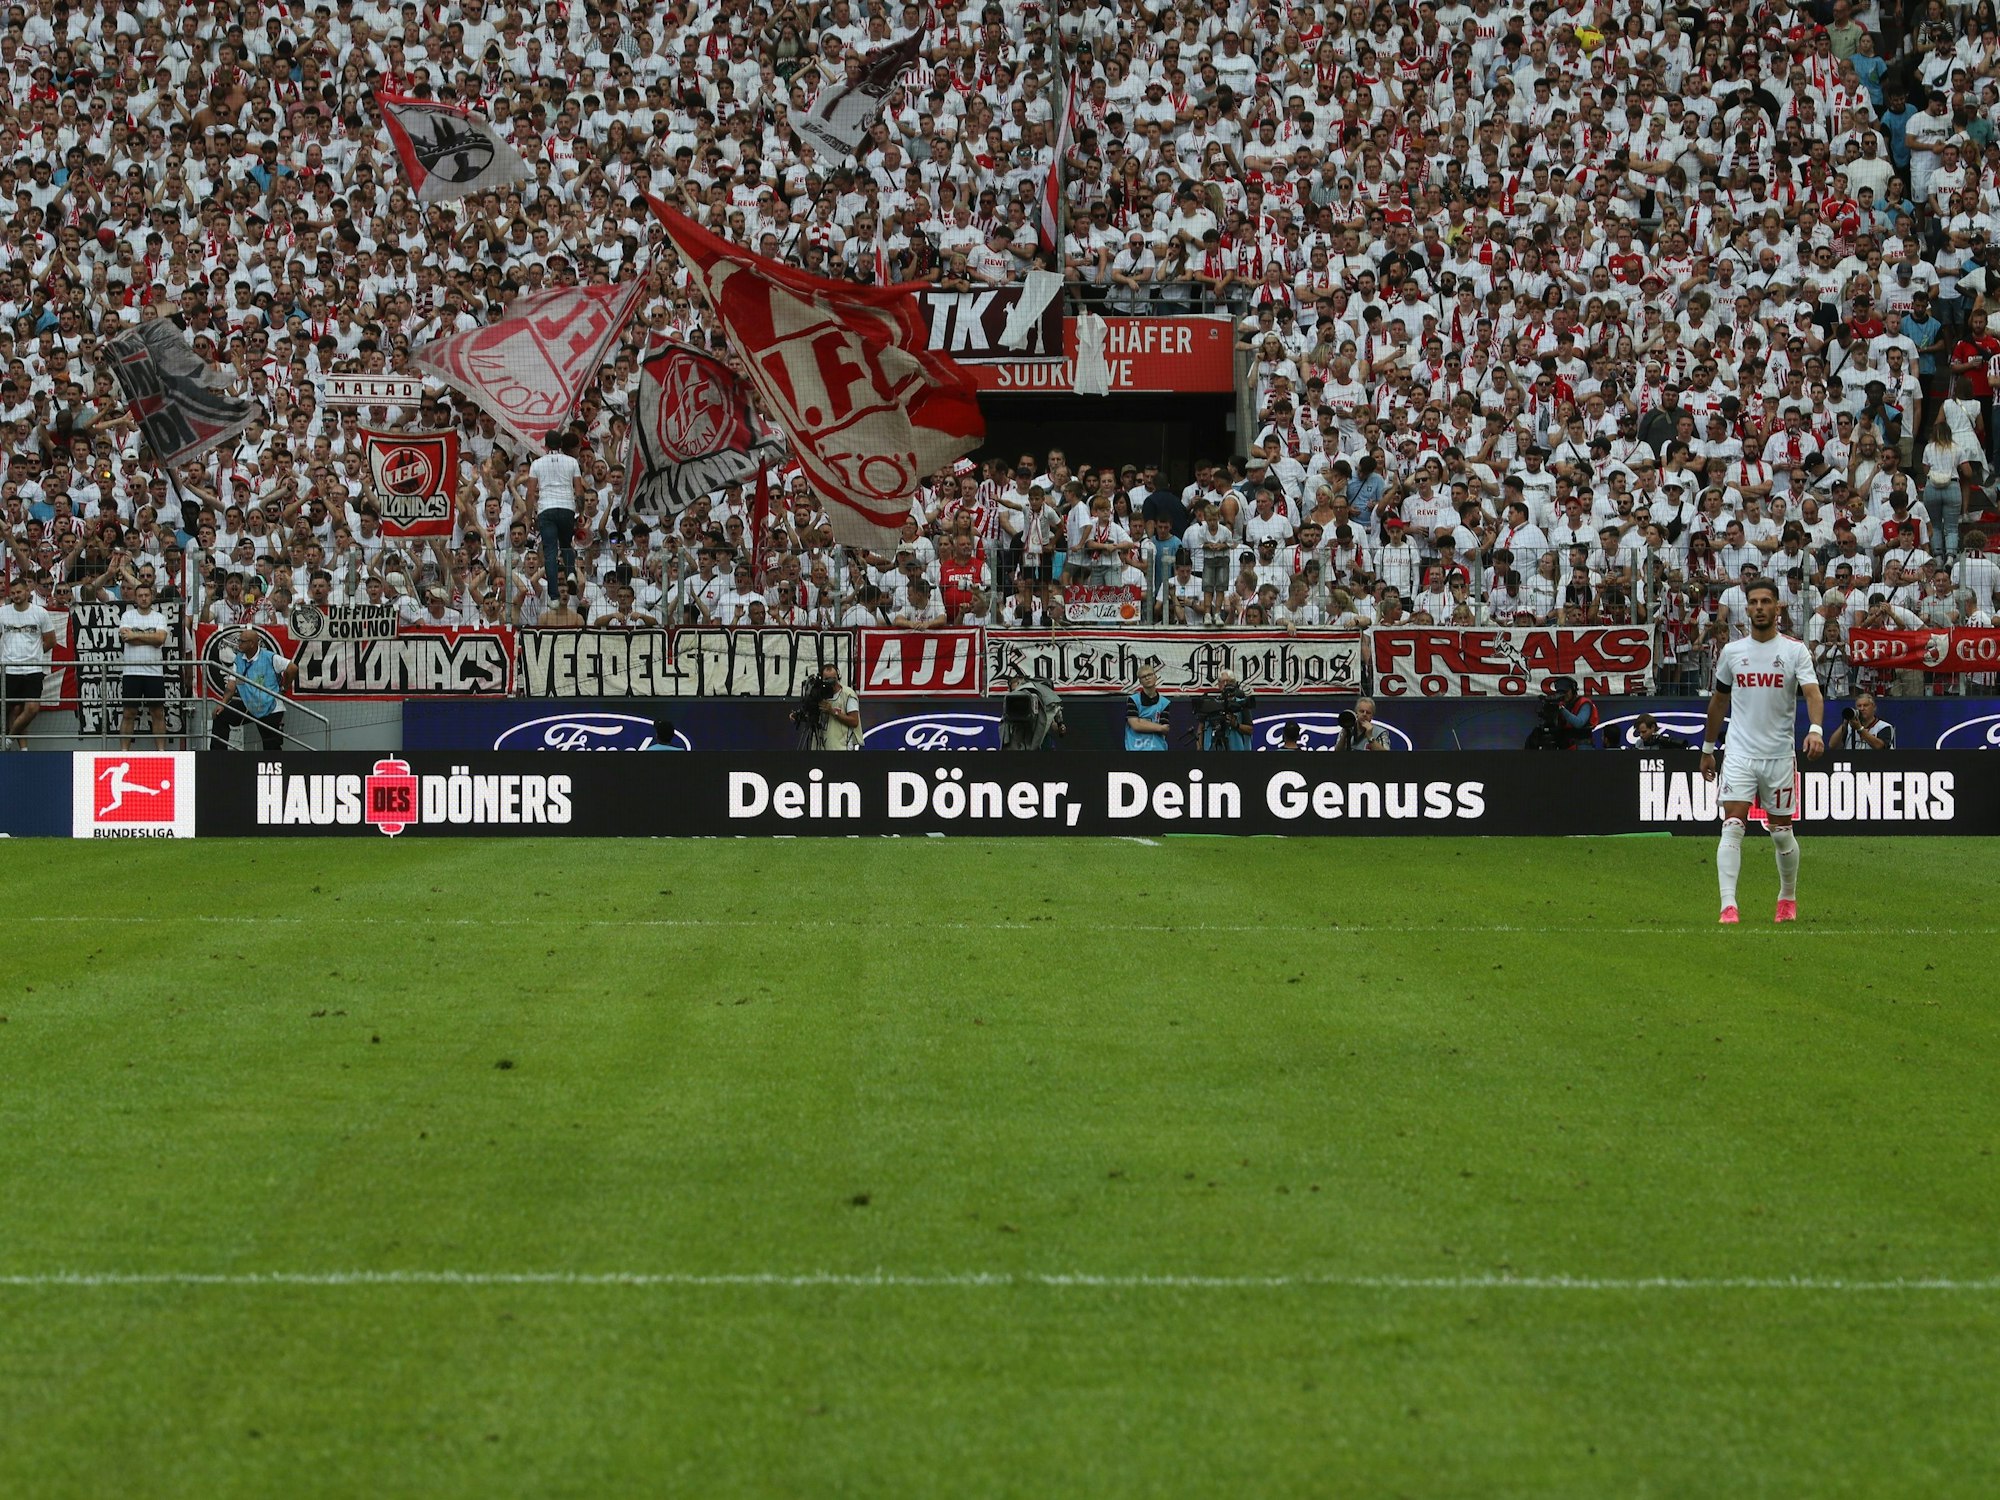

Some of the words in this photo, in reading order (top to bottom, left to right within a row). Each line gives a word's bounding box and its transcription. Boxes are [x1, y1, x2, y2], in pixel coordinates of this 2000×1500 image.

[984, 258, 1007, 267] REWE
[911, 290, 998, 351] TK
[1075, 321, 1192, 354] HÄFER
[335, 382, 411, 396] MALAD
[299, 640, 503, 691] COLONIACS
[869, 638, 969, 686] AJJ
[1373, 629, 1652, 675] FREAKS
[1956, 637, 2000, 661] GO
[1181, 643, 1358, 693] Mythos
[1736, 673, 1784, 688] REWE
[258, 762, 282, 774] DAS
[1640, 759, 1664, 771] DAS
[257, 775, 362, 824] HAUS
[373, 787, 410, 812] DES
[422, 766, 572, 824] DÖNERS
[728, 769, 861, 819] Dein
[888, 768, 1082, 827] Döner,
[1108, 769, 1241, 819] Dein
[1266, 771, 1485, 820] Genuss
[1640, 772, 1724, 821] HAU
[1804, 763, 1955, 820] DÖNERS
[1773, 787, 1793, 809] 17
[93, 829, 175, 838] BUNDESLIGA
